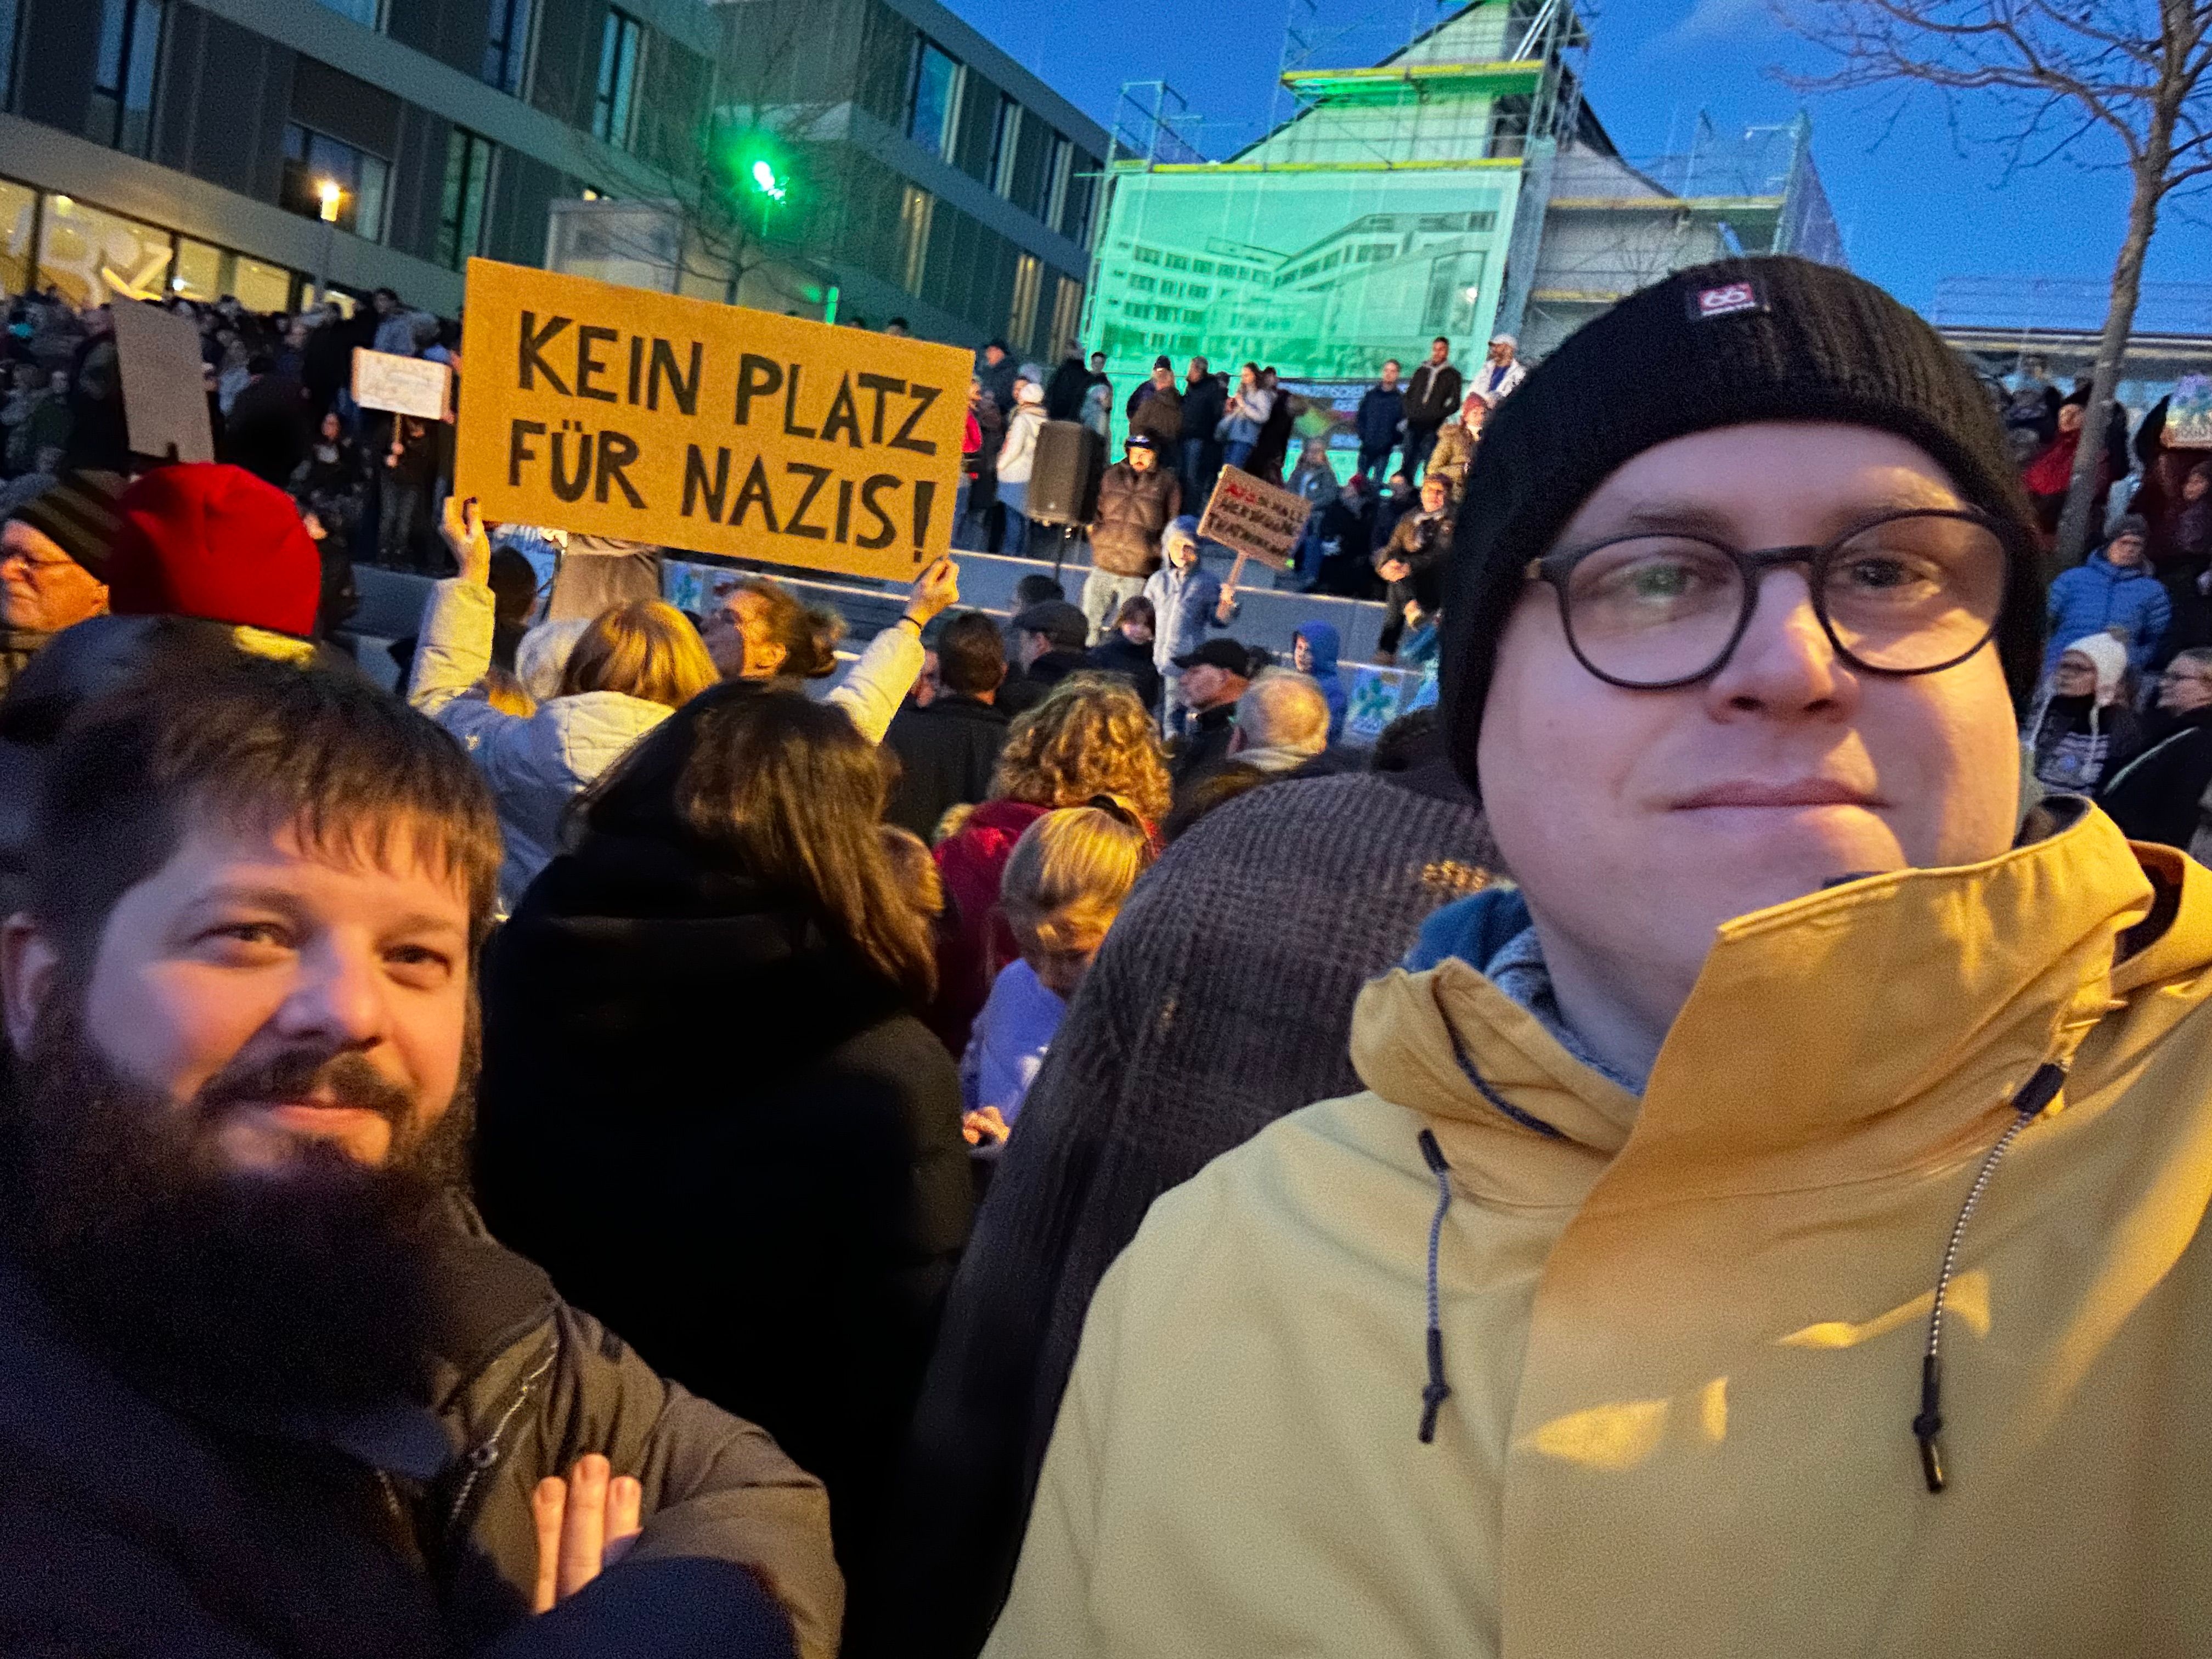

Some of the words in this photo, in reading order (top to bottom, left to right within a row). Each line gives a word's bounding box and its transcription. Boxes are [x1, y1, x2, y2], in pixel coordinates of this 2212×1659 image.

[518, 310, 703, 416] KEIN
[733, 353, 943, 456] PLATZ
[509, 419, 647, 510] FÜR
[680, 443, 936, 563] NAZIS!
